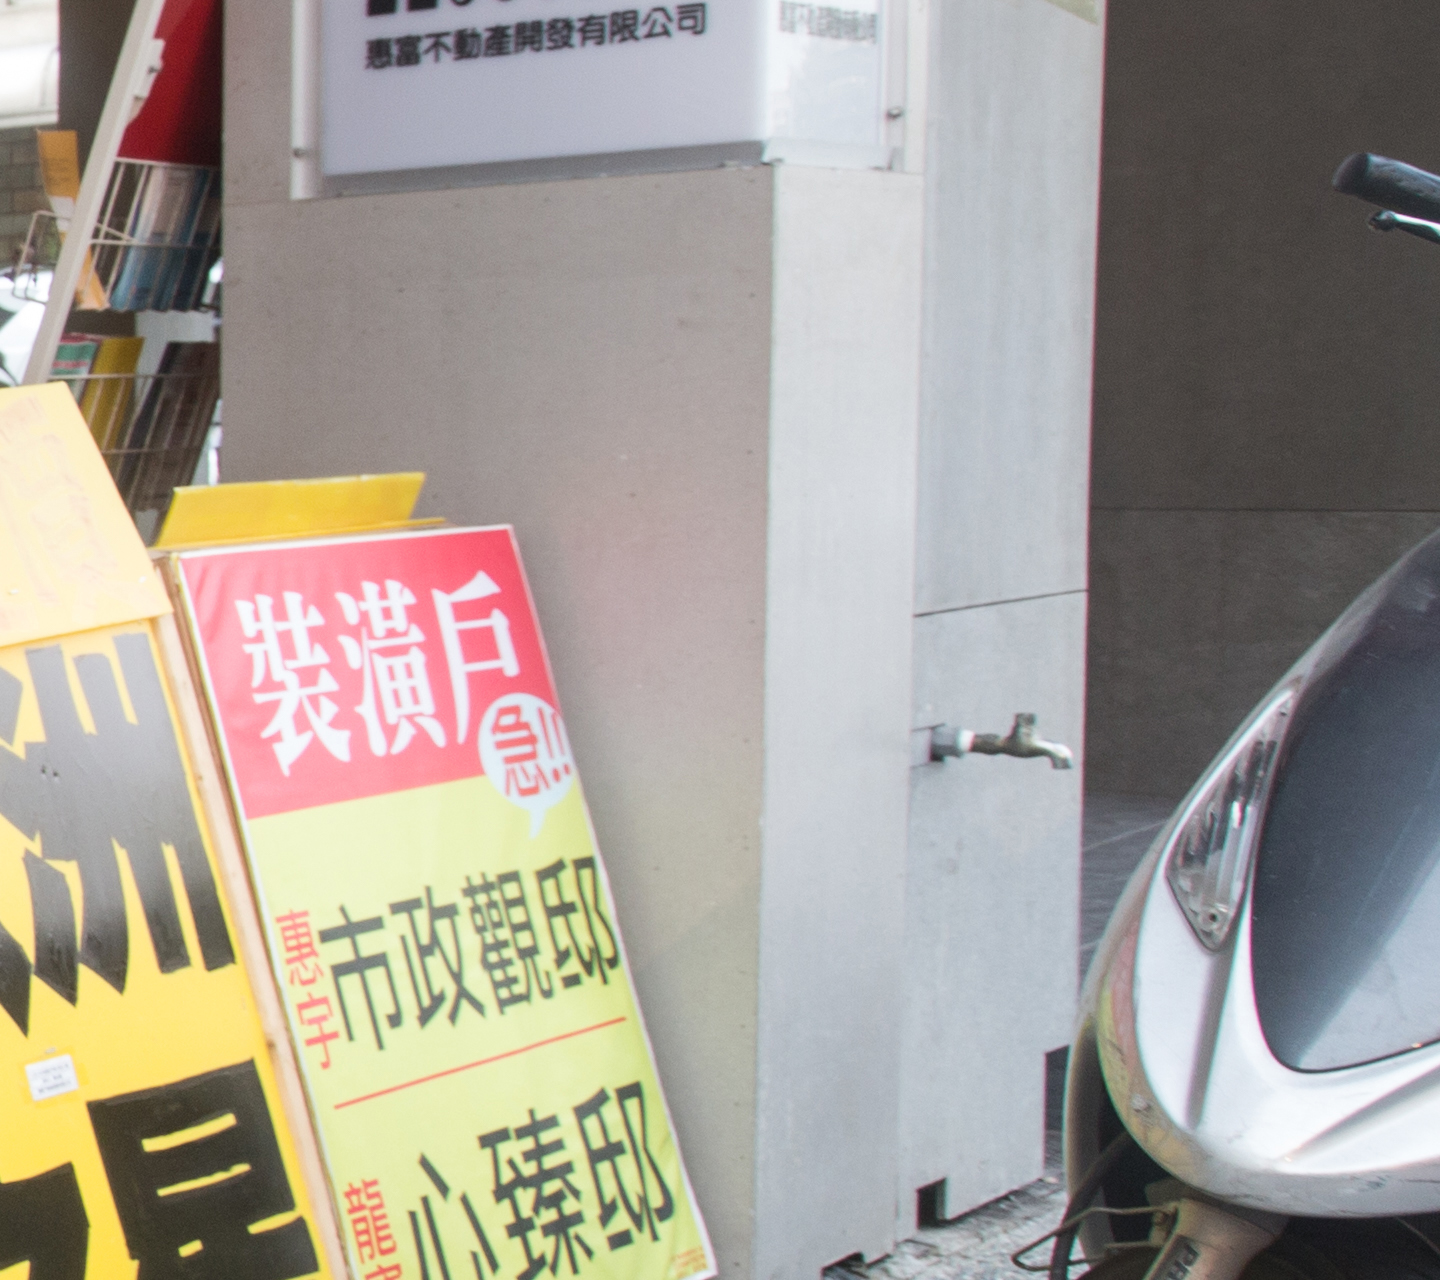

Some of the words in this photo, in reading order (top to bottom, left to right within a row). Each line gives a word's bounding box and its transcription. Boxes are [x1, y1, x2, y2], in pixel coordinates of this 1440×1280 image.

[236, 572, 520, 778] 裝潢戶
[278, 907, 337, 1072] 惠宇
[321, 856, 621, 1056] 市政觀邸
